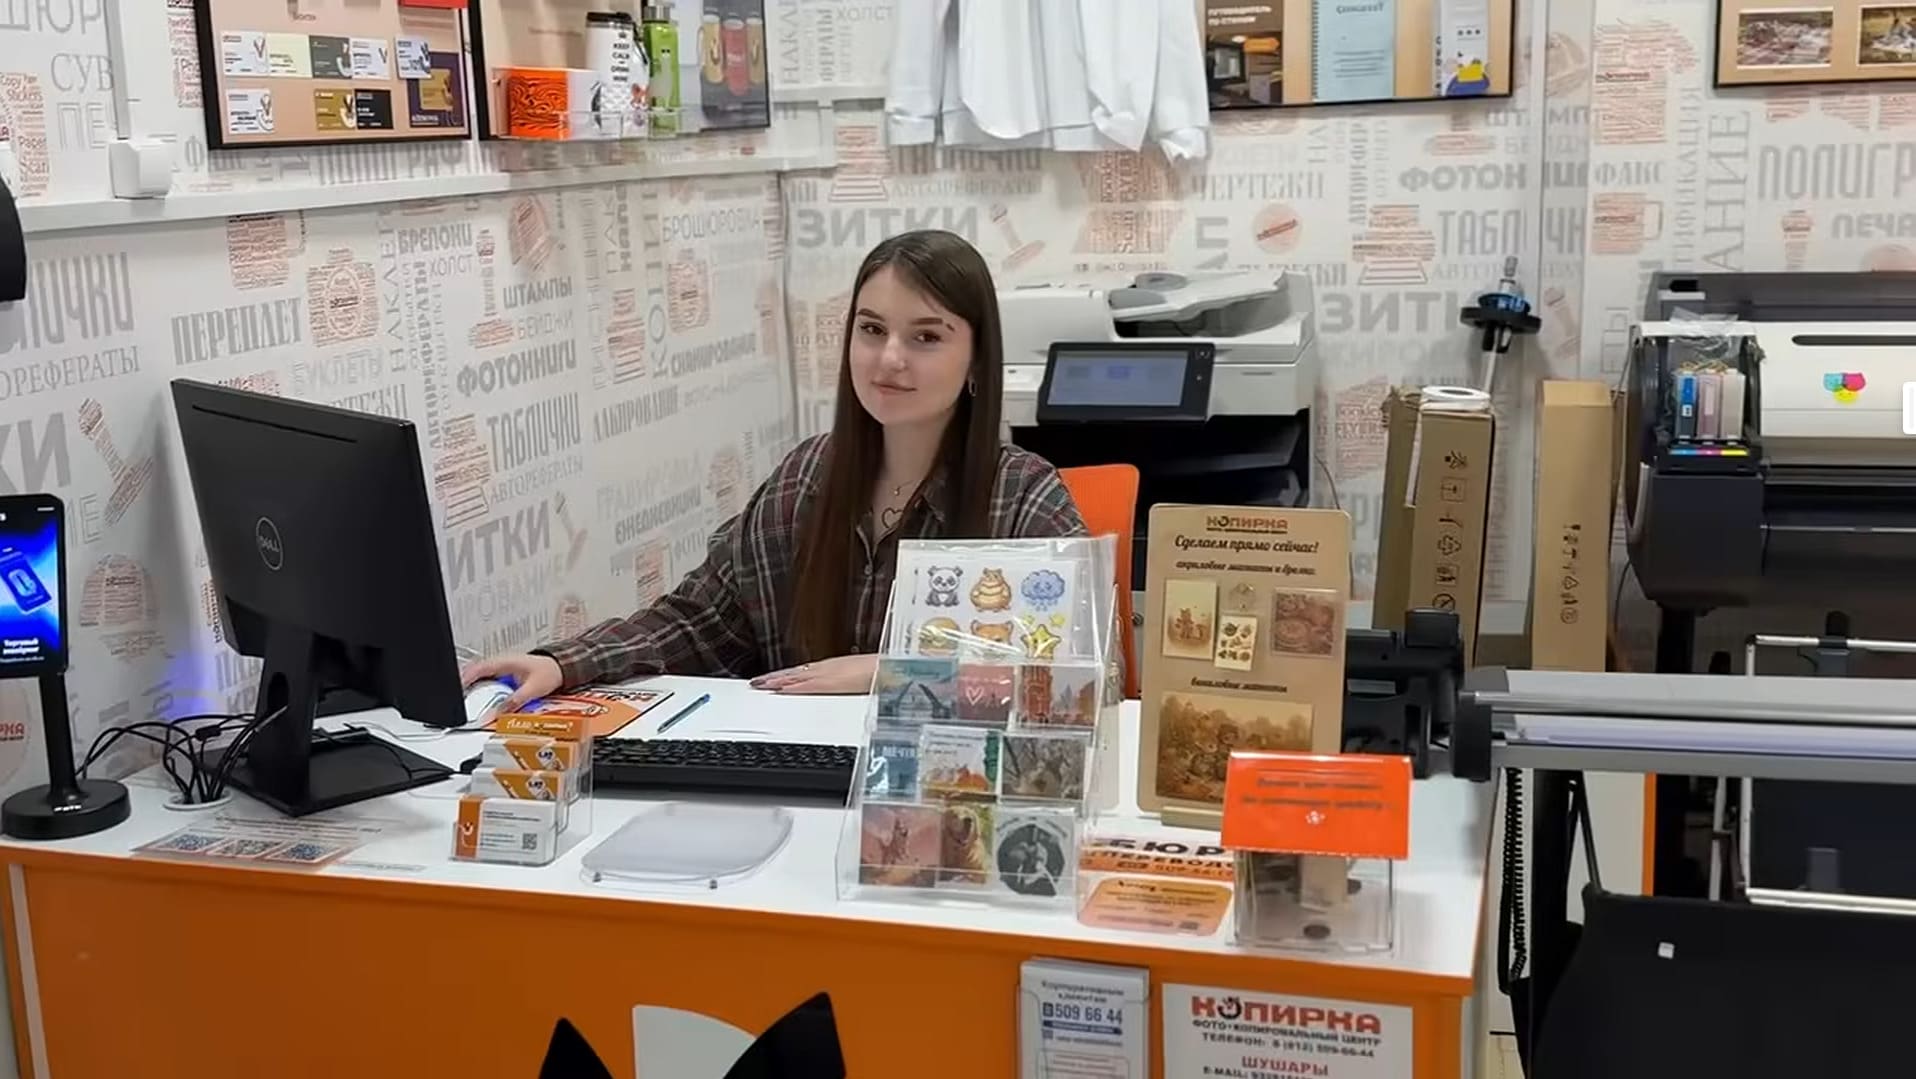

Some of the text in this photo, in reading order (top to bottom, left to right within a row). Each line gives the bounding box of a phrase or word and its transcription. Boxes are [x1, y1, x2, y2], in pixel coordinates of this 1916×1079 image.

[1175, 535, 1319, 553] Сделаем прямо сейчас!
[1055, 1003, 1123, 1024] 509 66 44
[1191, 996, 1382, 1035] КОПИРКА
[1341, 1035, 1382, 1048] ЦЕНТР
[1242, 1056, 1329, 1076] ШУШАРЫ
